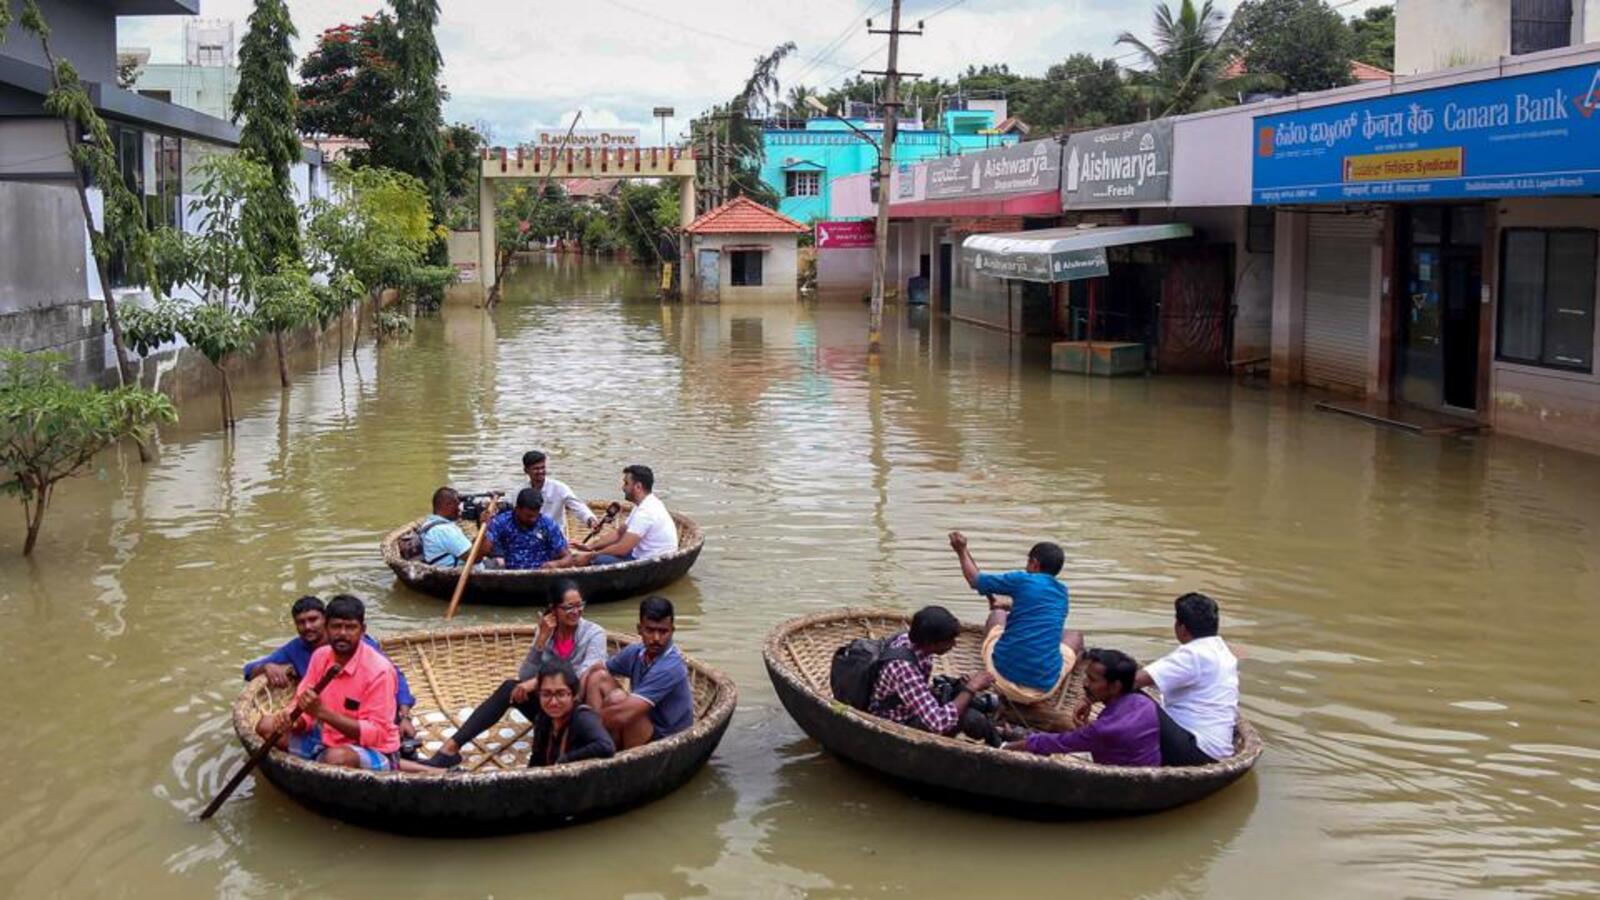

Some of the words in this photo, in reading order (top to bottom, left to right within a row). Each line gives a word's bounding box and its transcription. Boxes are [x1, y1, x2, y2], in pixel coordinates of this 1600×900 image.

[1443, 102, 1508, 131] Canara
[1514, 88, 1568, 124] Bank
[540, 132, 598, 145] Rainbow
[600, 132, 636, 145] Drive
[984, 155, 1047, 178] Aishwarya
[1080, 151, 1156, 186] Aishwarya
[1416, 158, 1458, 176] Syndicate
[1062, 256, 1105, 271] Aishwarya
